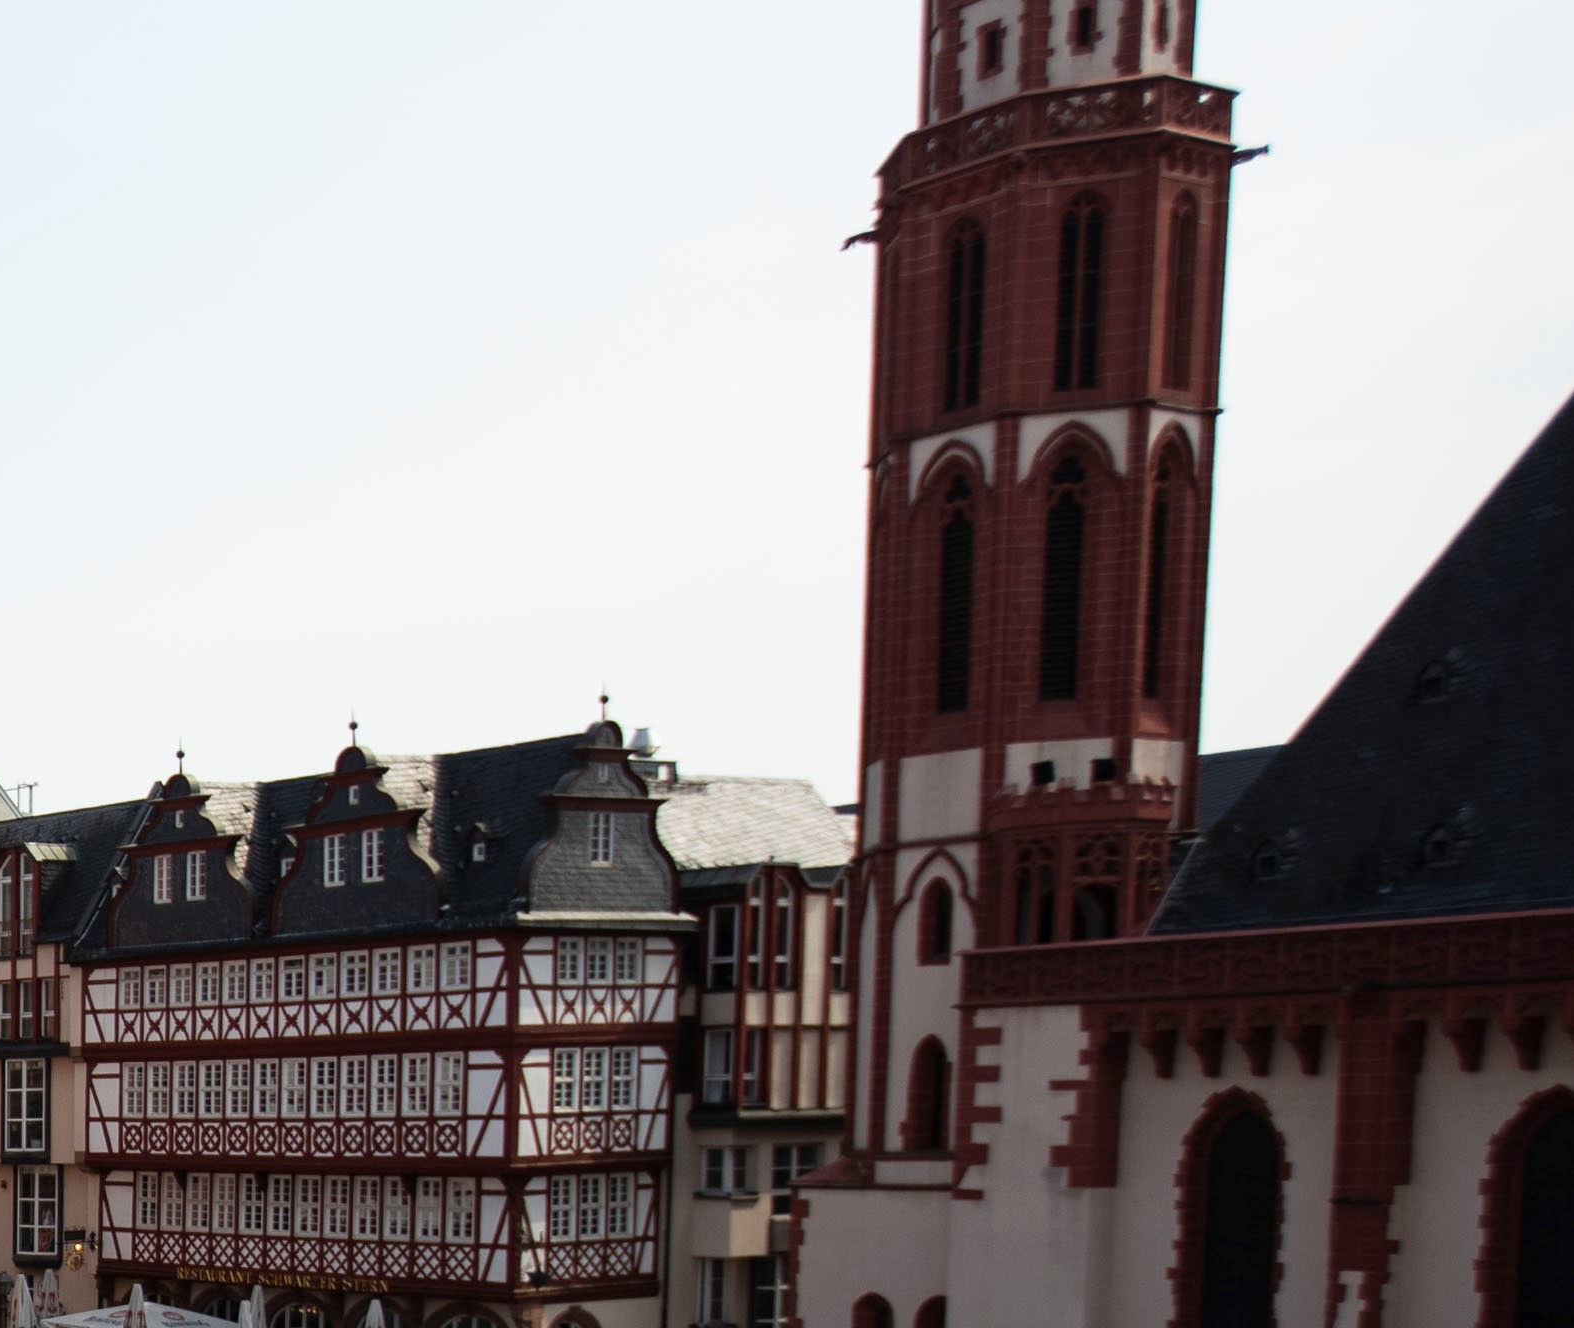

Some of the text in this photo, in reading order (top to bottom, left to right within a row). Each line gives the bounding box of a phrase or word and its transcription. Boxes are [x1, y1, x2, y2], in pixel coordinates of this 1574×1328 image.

[175, 1266, 389, 1293] RESTAURANT SCHWARZER STERN
